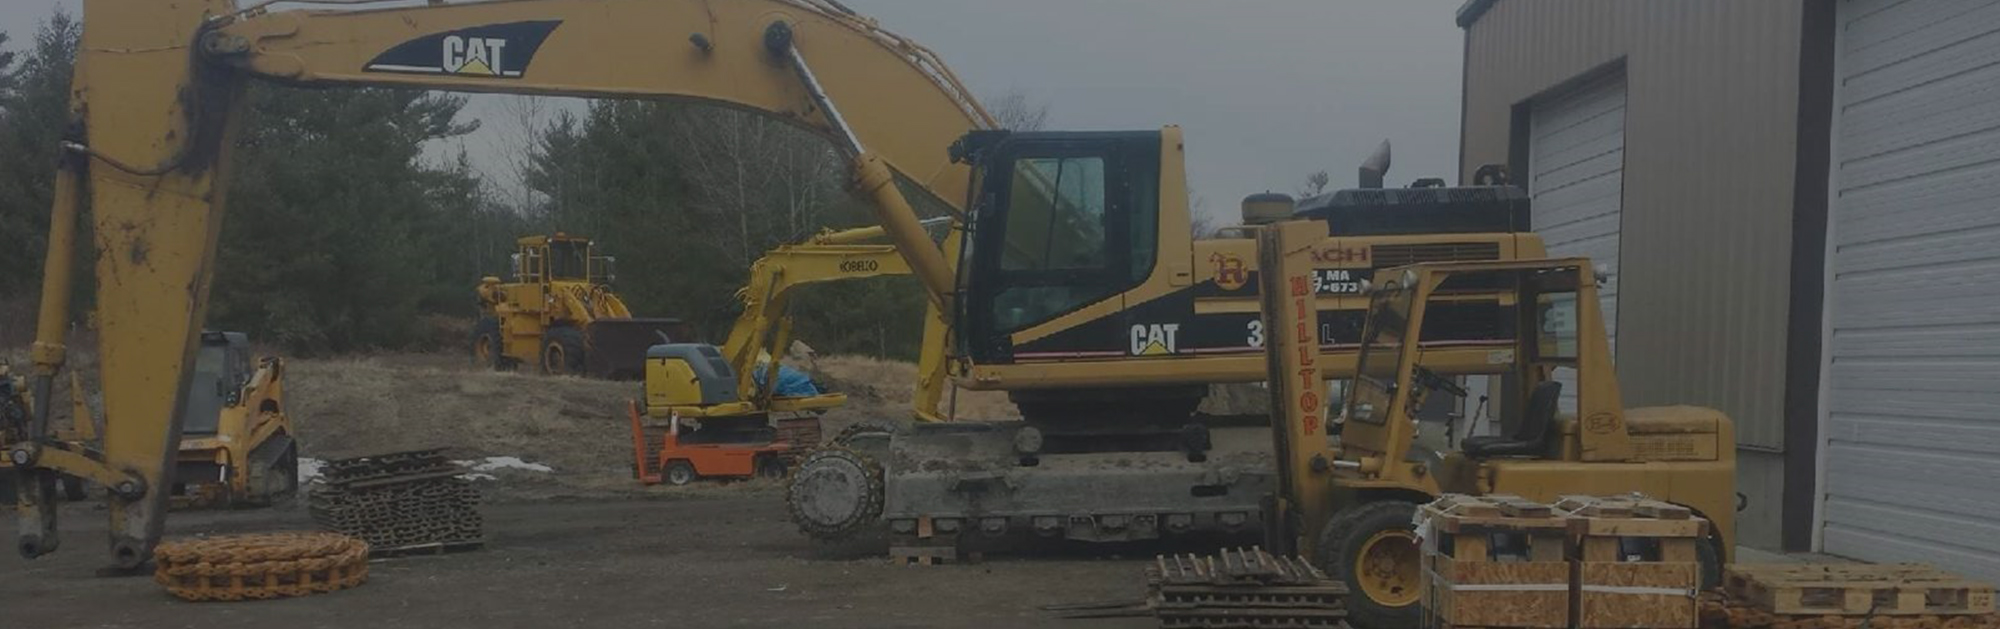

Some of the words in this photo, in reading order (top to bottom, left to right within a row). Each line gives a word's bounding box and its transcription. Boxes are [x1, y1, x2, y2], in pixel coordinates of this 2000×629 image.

[443, 35, 506, 76] CAT
[1326, 270, 1350, 281] MA
[1130, 324, 1180, 355] CAT
